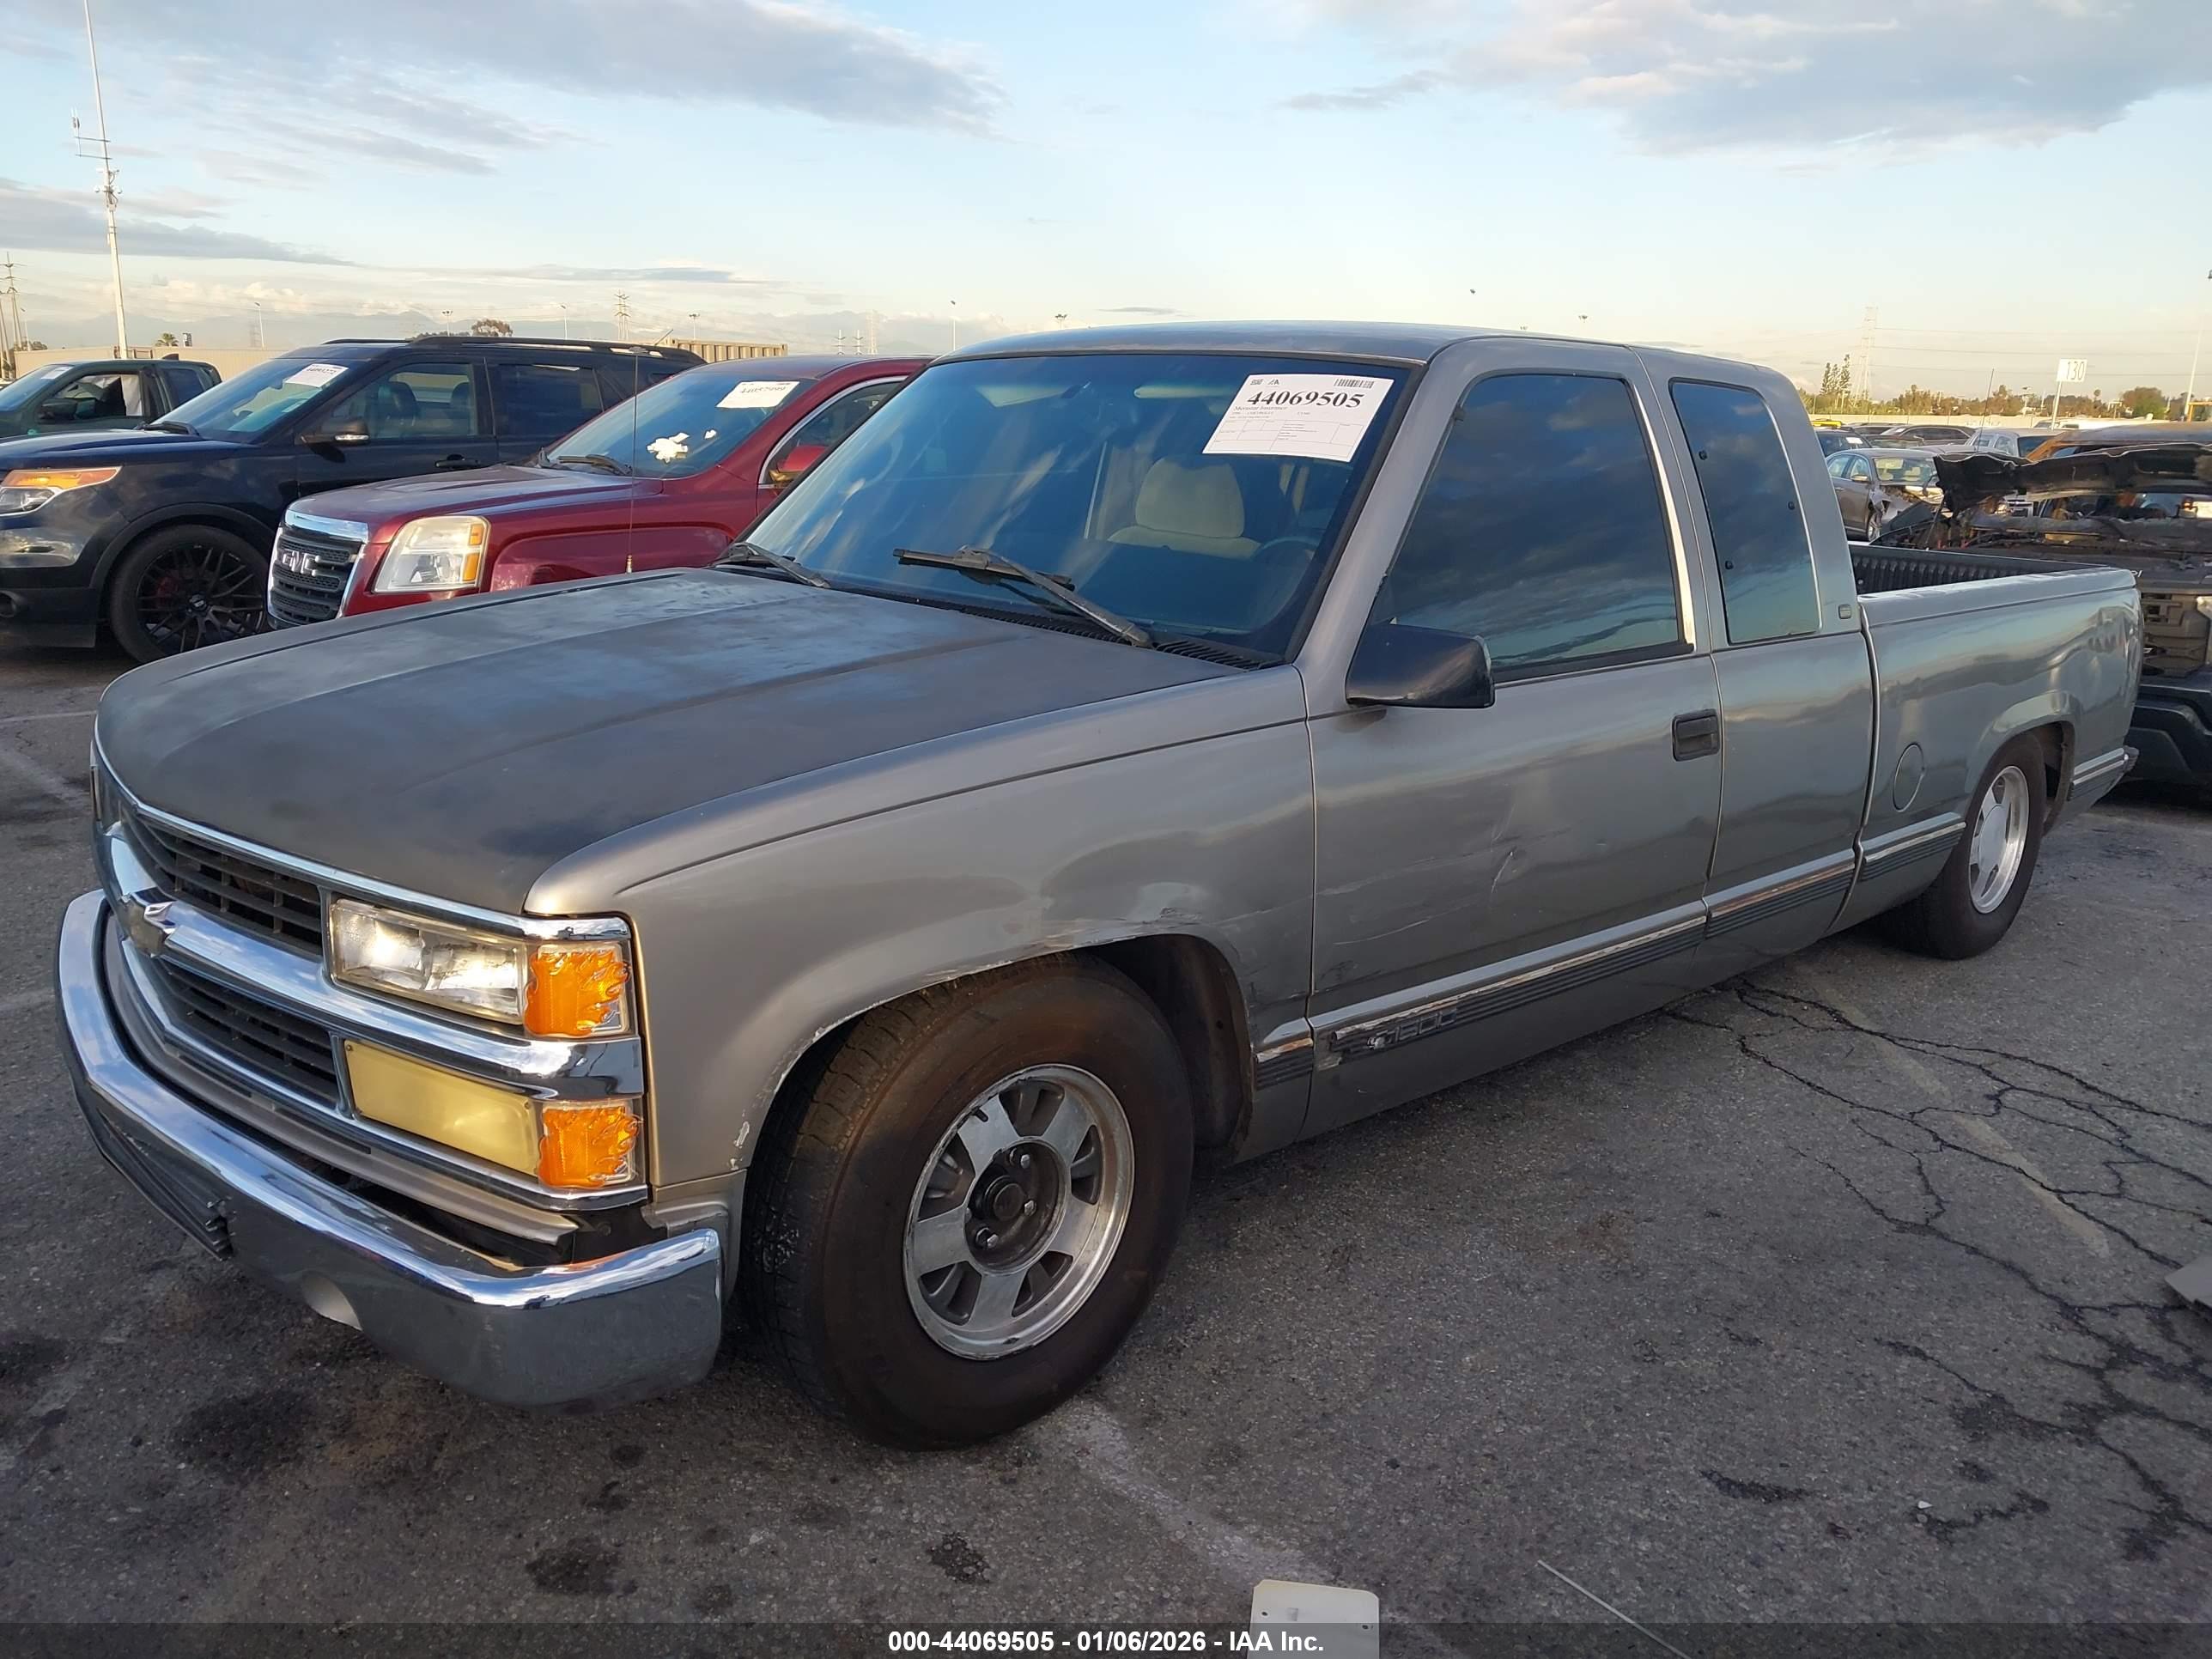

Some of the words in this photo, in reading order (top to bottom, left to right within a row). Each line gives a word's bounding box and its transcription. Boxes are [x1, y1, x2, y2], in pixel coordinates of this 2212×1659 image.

[2066, 361, 2085, 380] 130
[1247, 391, 1364, 408] 44069505
[282, 549, 321, 577] GMC
